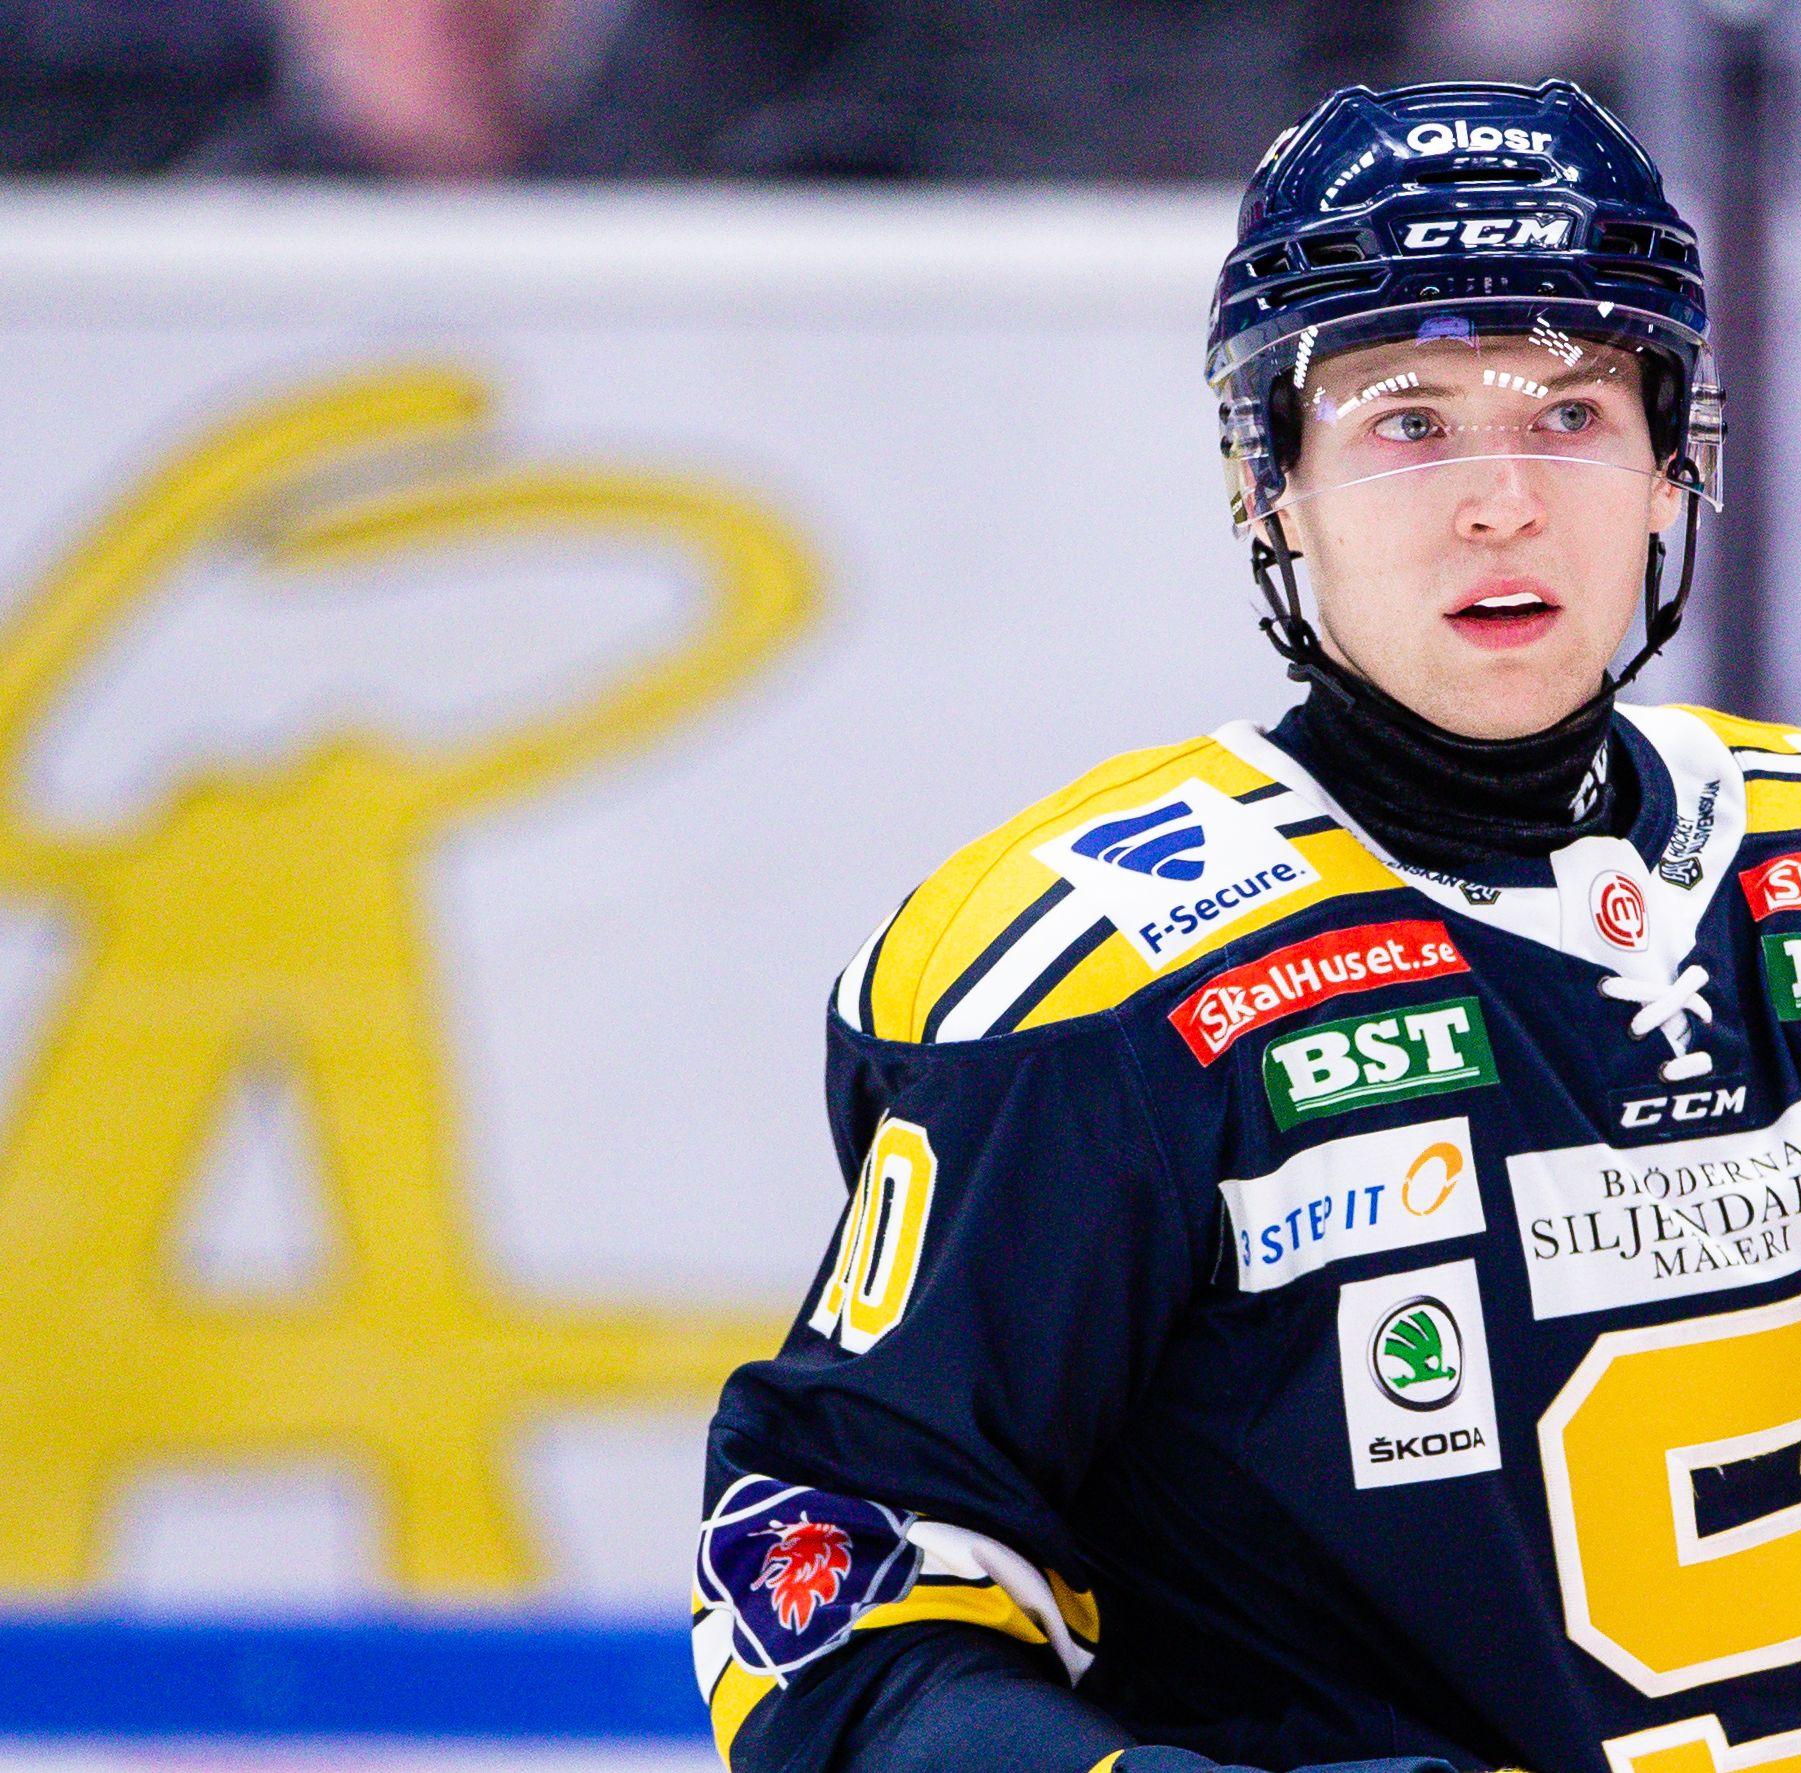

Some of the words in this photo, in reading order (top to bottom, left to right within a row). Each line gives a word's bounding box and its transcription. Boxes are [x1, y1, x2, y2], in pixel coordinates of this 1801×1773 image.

[1406, 120, 1552, 156] Qlosr
[1403, 217, 1571, 249] CCM
[1271, 1006, 1470, 1101] BST
[1619, 1086, 1747, 1129] CCM
[1345, 1185, 1386, 1230] IT
[1369, 1427, 1486, 1463] ŠKODA
